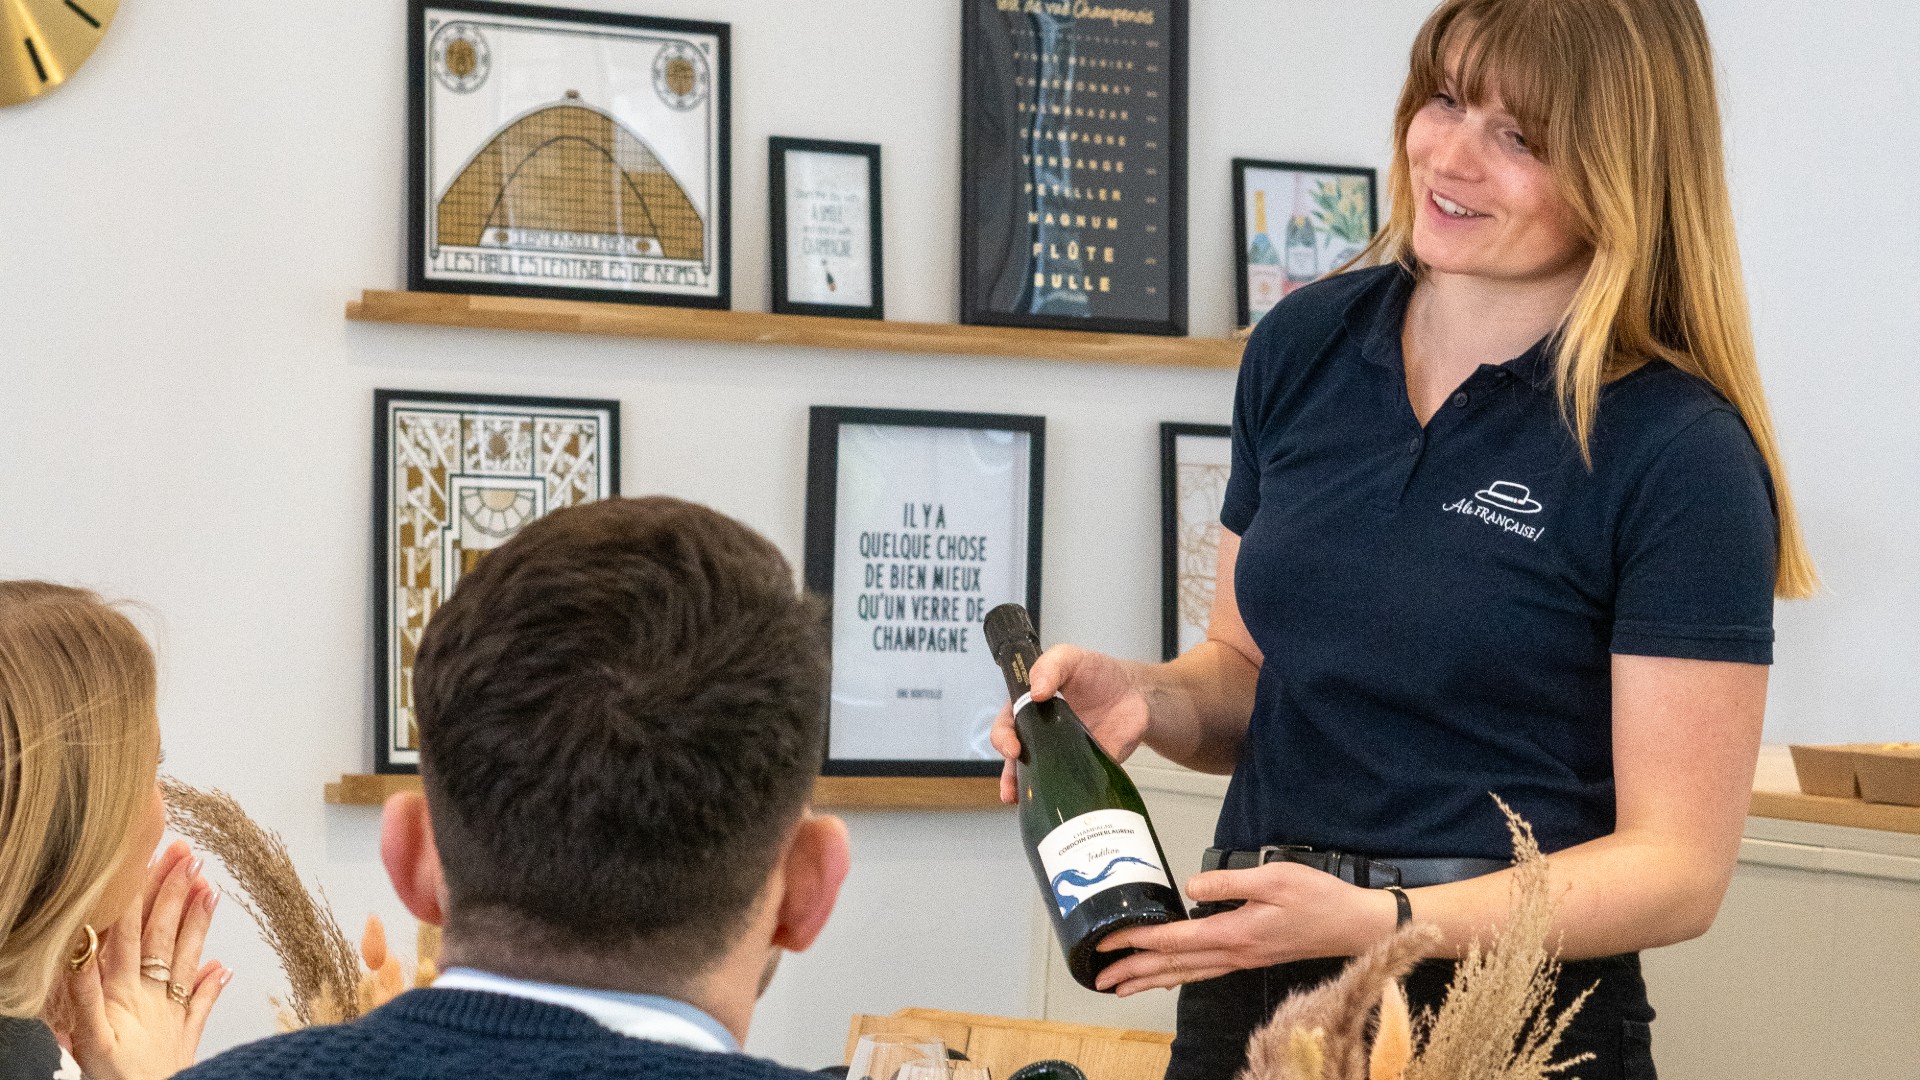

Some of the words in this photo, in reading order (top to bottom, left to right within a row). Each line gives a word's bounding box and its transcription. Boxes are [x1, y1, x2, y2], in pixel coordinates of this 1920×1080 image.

[1019, 127, 1127, 148] CHAMPAGNE
[1021, 154, 1125, 174] VENDANGE
[1027, 211, 1119, 232] MAGNUM
[443, 251, 475, 273] LES
[477, 254, 538, 278] HALLES
[653, 264, 699, 286] REIMS
[1033, 272, 1112, 293] BULLE
[903, 502, 917, 529] IL
[922, 503, 933, 529] Y
[935, 503, 946, 529] A
[859, 531, 931, 561] QUELQUE
[936, 535, 987, 562] CHOSE
[864, 563, 885, 589] DE
[890, 563, 927, 590] BIEN
[932, 566, 981, 593] MIEUX
[857, 593, 906, 621] QU'UN
[912, 595, 960, 623] VERRE
[966, 597, 985, 624] DE
[872, 625, 968, 653] CHAMPAGNE
[1073, 824, 1114, 839] CHAMPAGNE
[1058, 836, 1087, 857] CORDOIN
